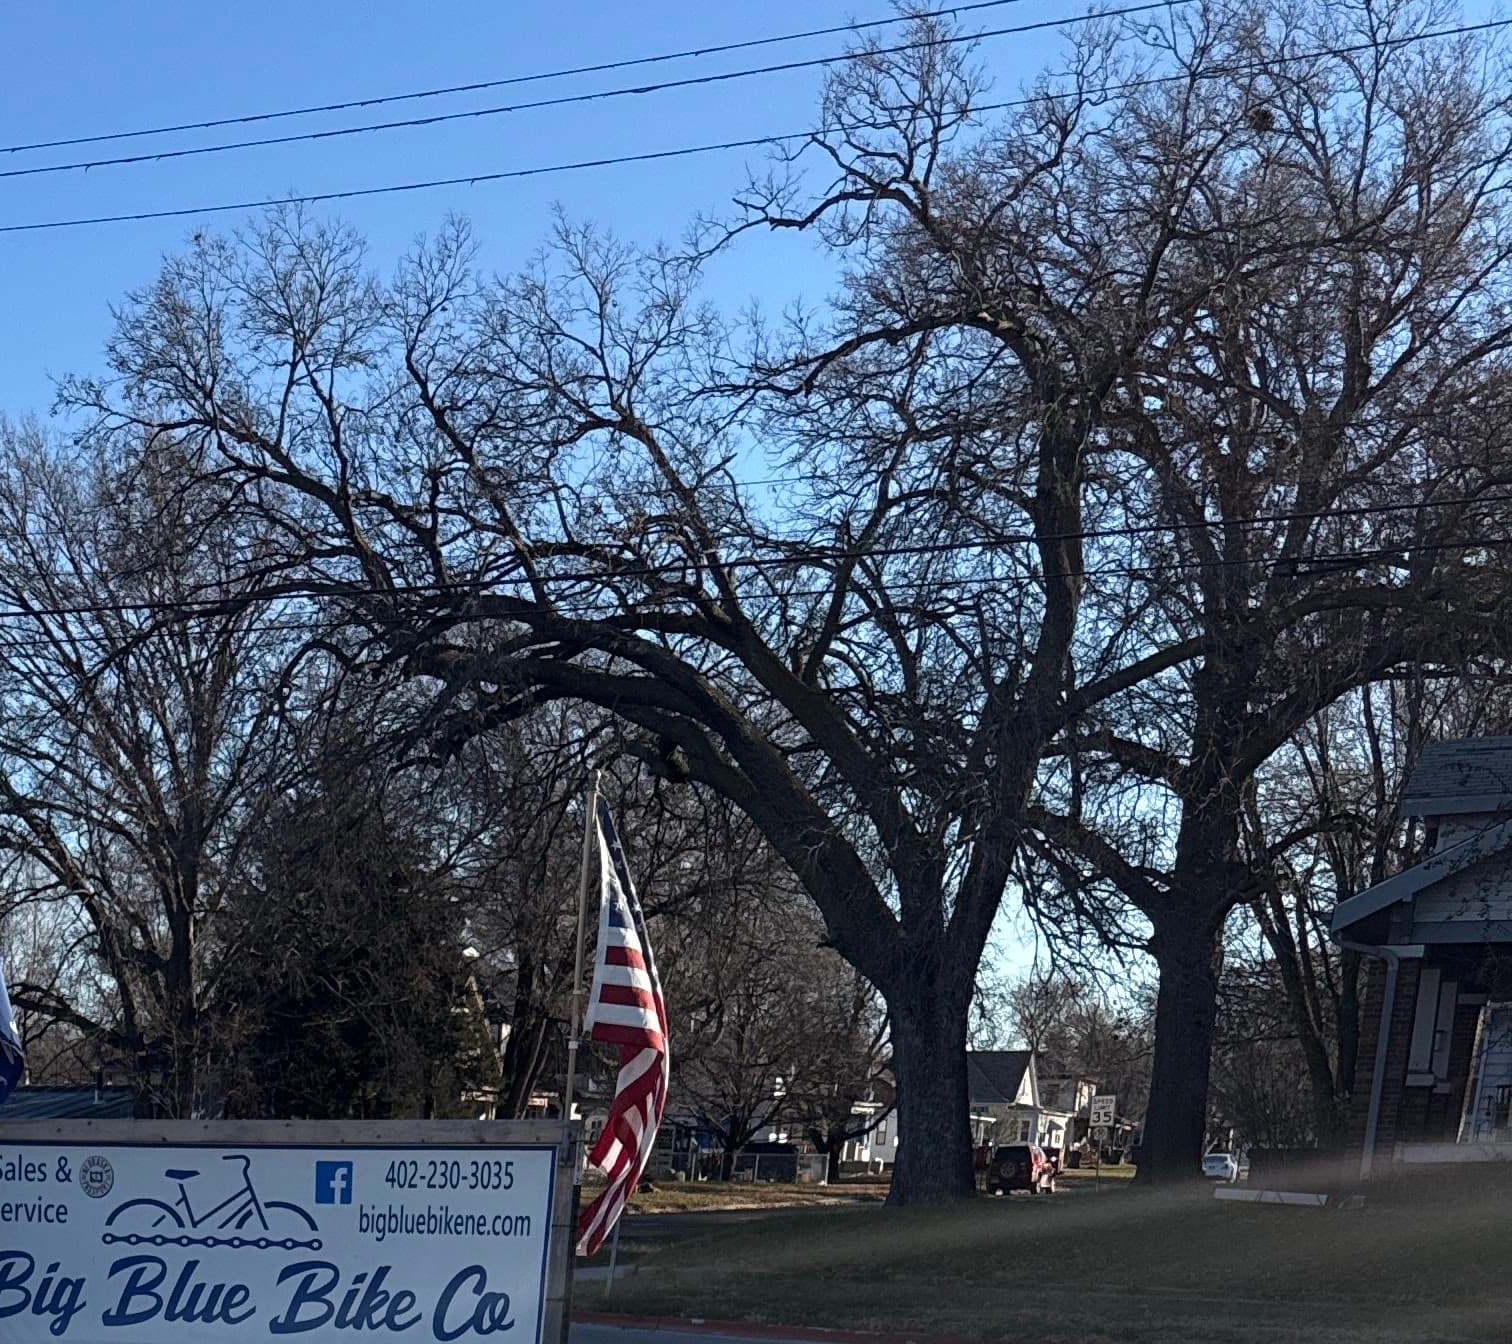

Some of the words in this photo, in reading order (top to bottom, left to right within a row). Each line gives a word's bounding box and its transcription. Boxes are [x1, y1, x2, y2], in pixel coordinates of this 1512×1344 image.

[1092, 1111, 1112, 1123] 35
[55, 1156, 72, 1182] &
[385, 1160, 514, 1190] 402-230-3035
[359, 1204, 531, 1242] bigbluebikene.com
[102, 1255, 256, 1327] Blue
[269, 1260, 422, 1335] Bike
[432, 1264, 515, 1342] Co
